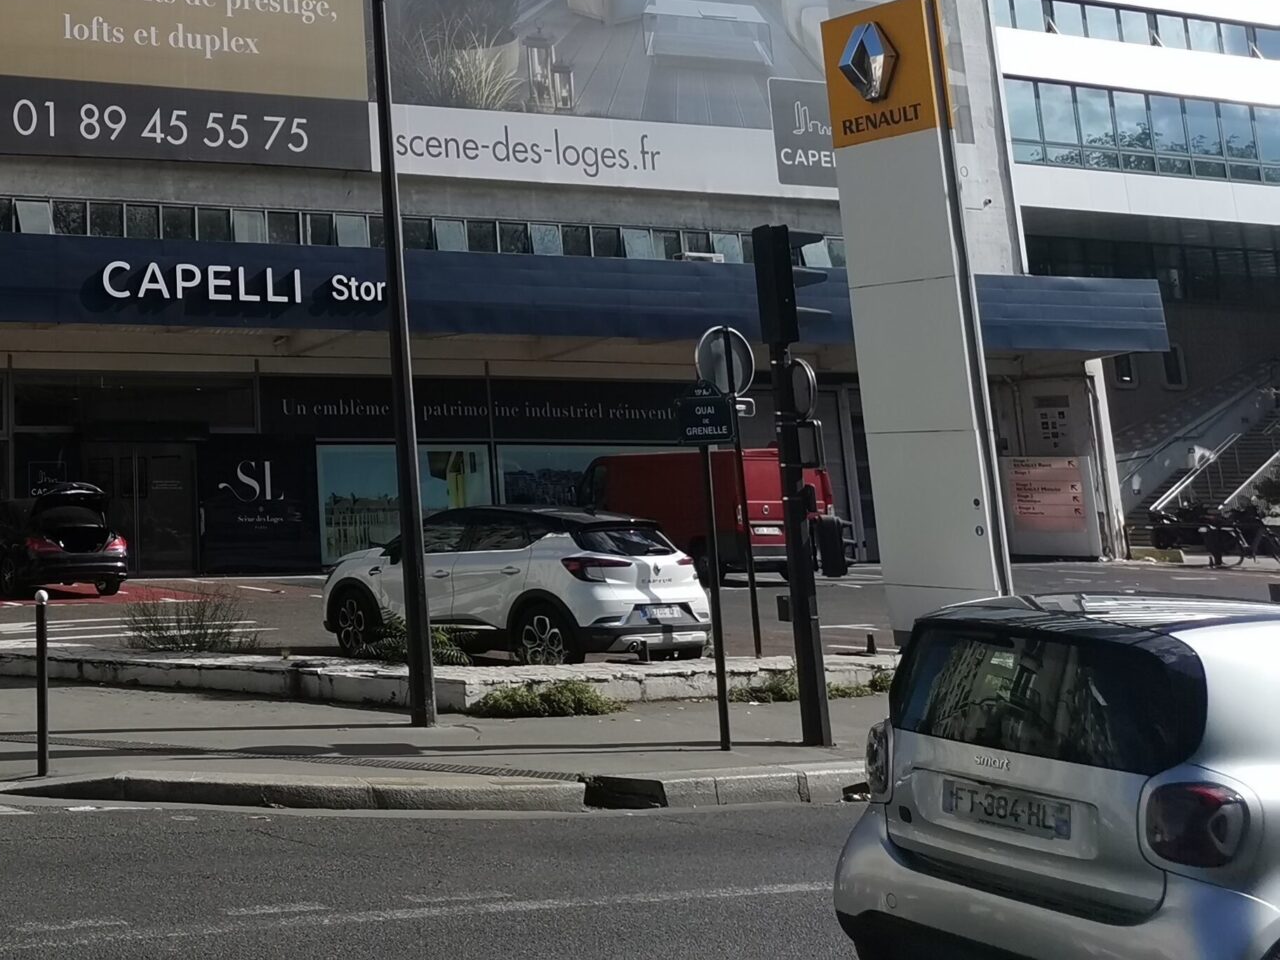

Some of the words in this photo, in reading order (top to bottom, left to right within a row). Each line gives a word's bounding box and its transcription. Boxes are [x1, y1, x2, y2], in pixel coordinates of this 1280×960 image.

[63, 13, 125, 44] lofts
[134, 23, 159, 47] et
[168, 23, 260, 59] duplex
[12, 98, 56, 137] 01
[79, 103, 127, 141] 89
[141, 108, 189, 145] 45
[203, 112, 250, 149] 55
[264, 116, 309, 152] 75
[842, 103, 921, 136] RENAULT
[396, 125, 661, 177] scene-des-loges.fr
[780, 148, 836, 168] CAPE
[103, 260, 302, 303] CAPELLI
[332, 274, 386, 301] Stor
[282, 399, 306, 416] Un
[314, 399, 390, 416] emblème
[525, 401, 603, 418] industriel
[609, 402, 675, 420] réinvent
[695, 406, 715, 415] QUAI
[686, 425, 728, 436] GRENELLE
[218, 460, 284, 502] SL
[974, 755, 1010, 771] smart
